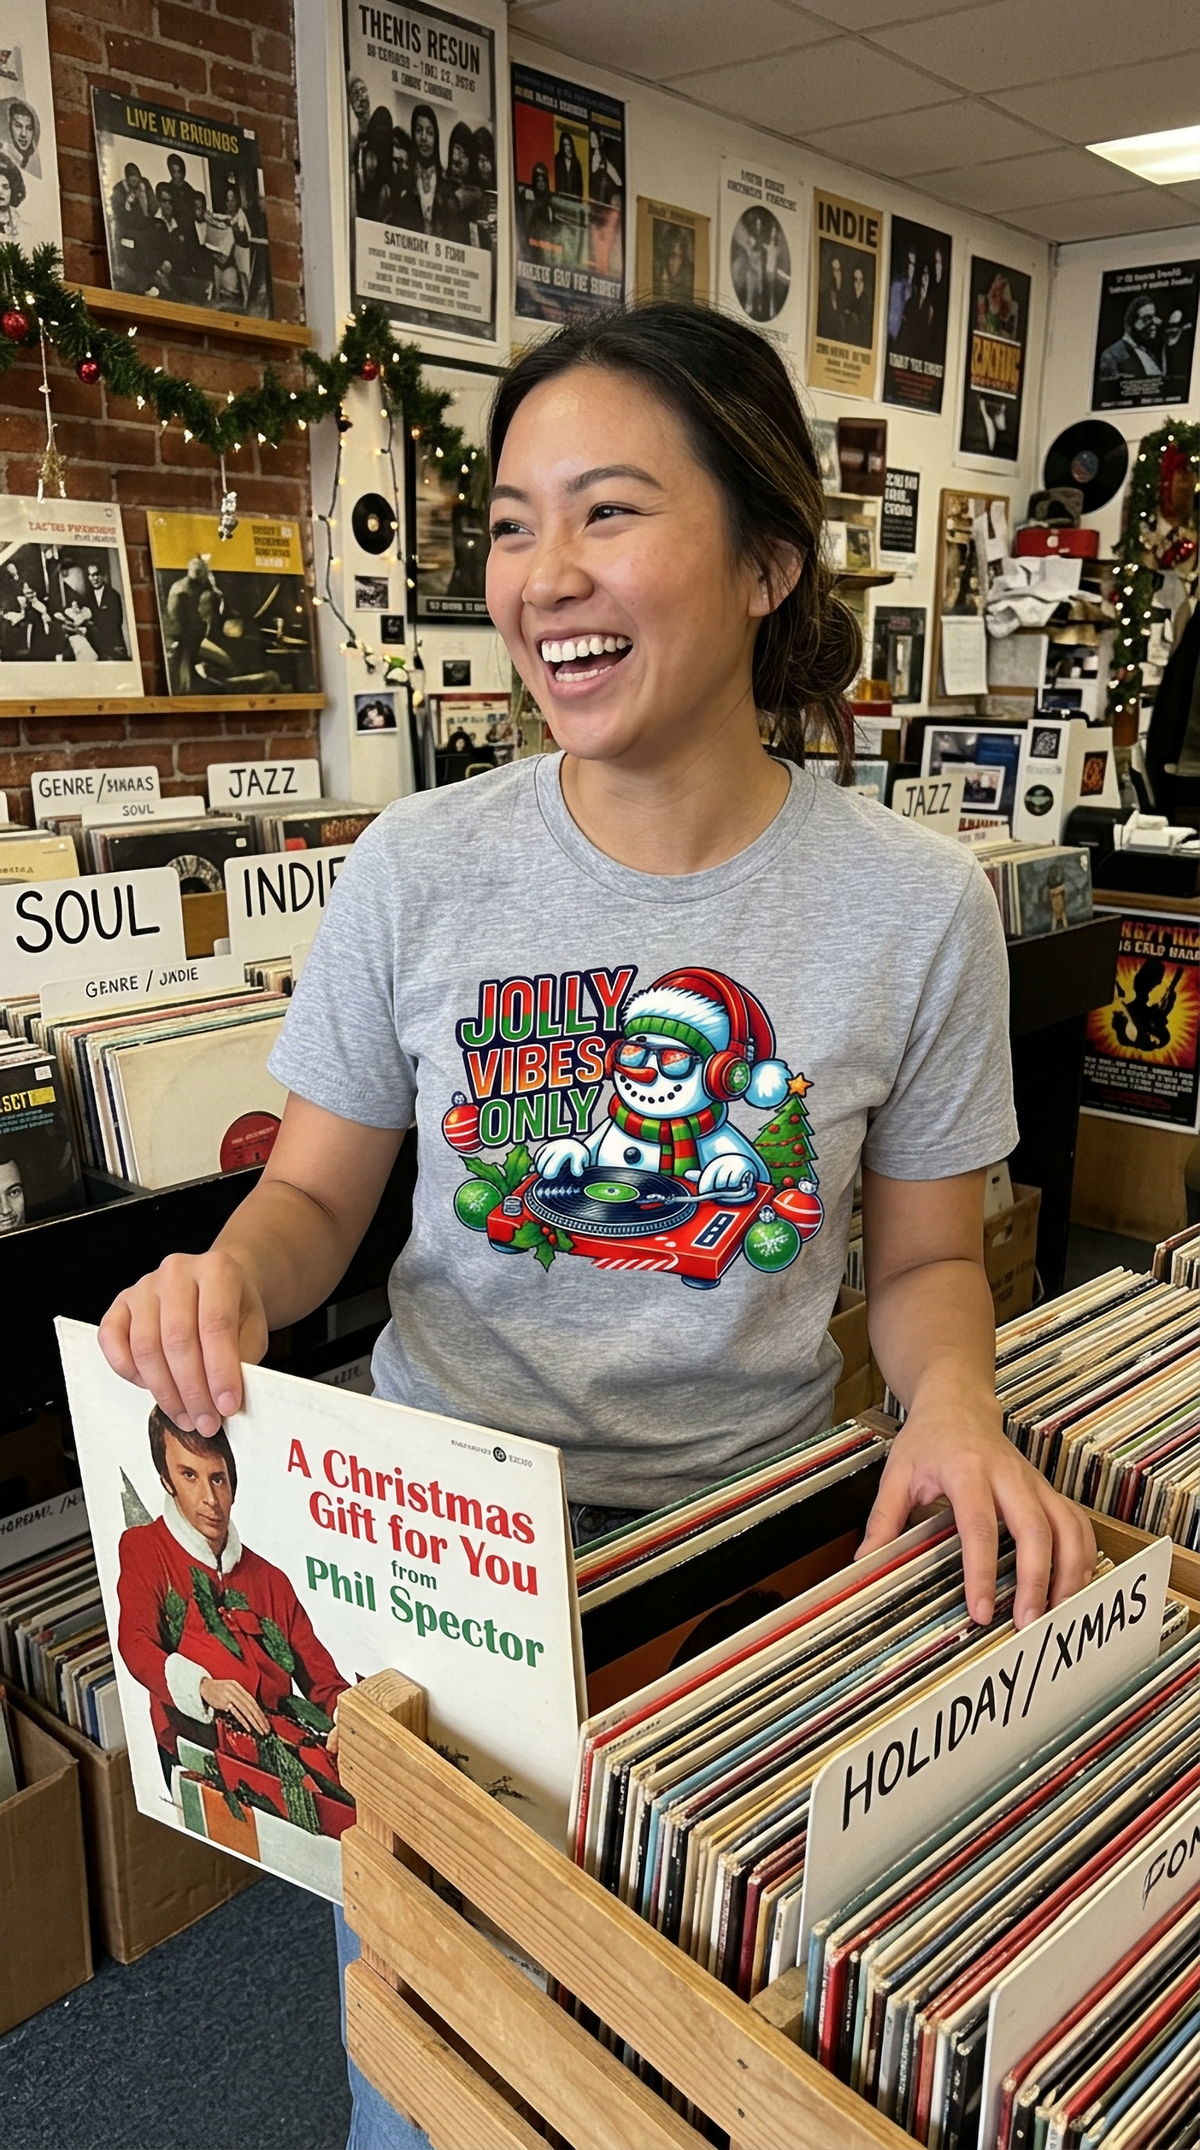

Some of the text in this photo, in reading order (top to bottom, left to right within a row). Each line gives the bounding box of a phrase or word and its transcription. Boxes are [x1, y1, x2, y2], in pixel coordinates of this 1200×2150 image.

[359, 4, 422, 54] THENIS
[427, 29, 480, 75] RESUN
[126, 106, 158, 133] LIVE
[818, 201, 879, 249] INDIE
[121, 804, 155, 817] SOUL
[228, 766, 298, 799] JAZZ
[902, 782, 952, 818] JAZZ
[15, 884, 161, 954] SOUL
[85, 975, 139, 998] GENRE
[458, 965, 636, 1047] JOLLY
[465, 1036, 606, 1099] VIBES
[478, 1084, 601, 1146] ONLY
[287, 1437, 536, 1545] A Christmas
[308, 1490, 539, 1597] Gift for You
[390, 1559, 438, 1591] from
[305, 1554, 545, 1669] Phil Spector
[842, 1572, 1148, 1833] HOLIDAY/XMAS
